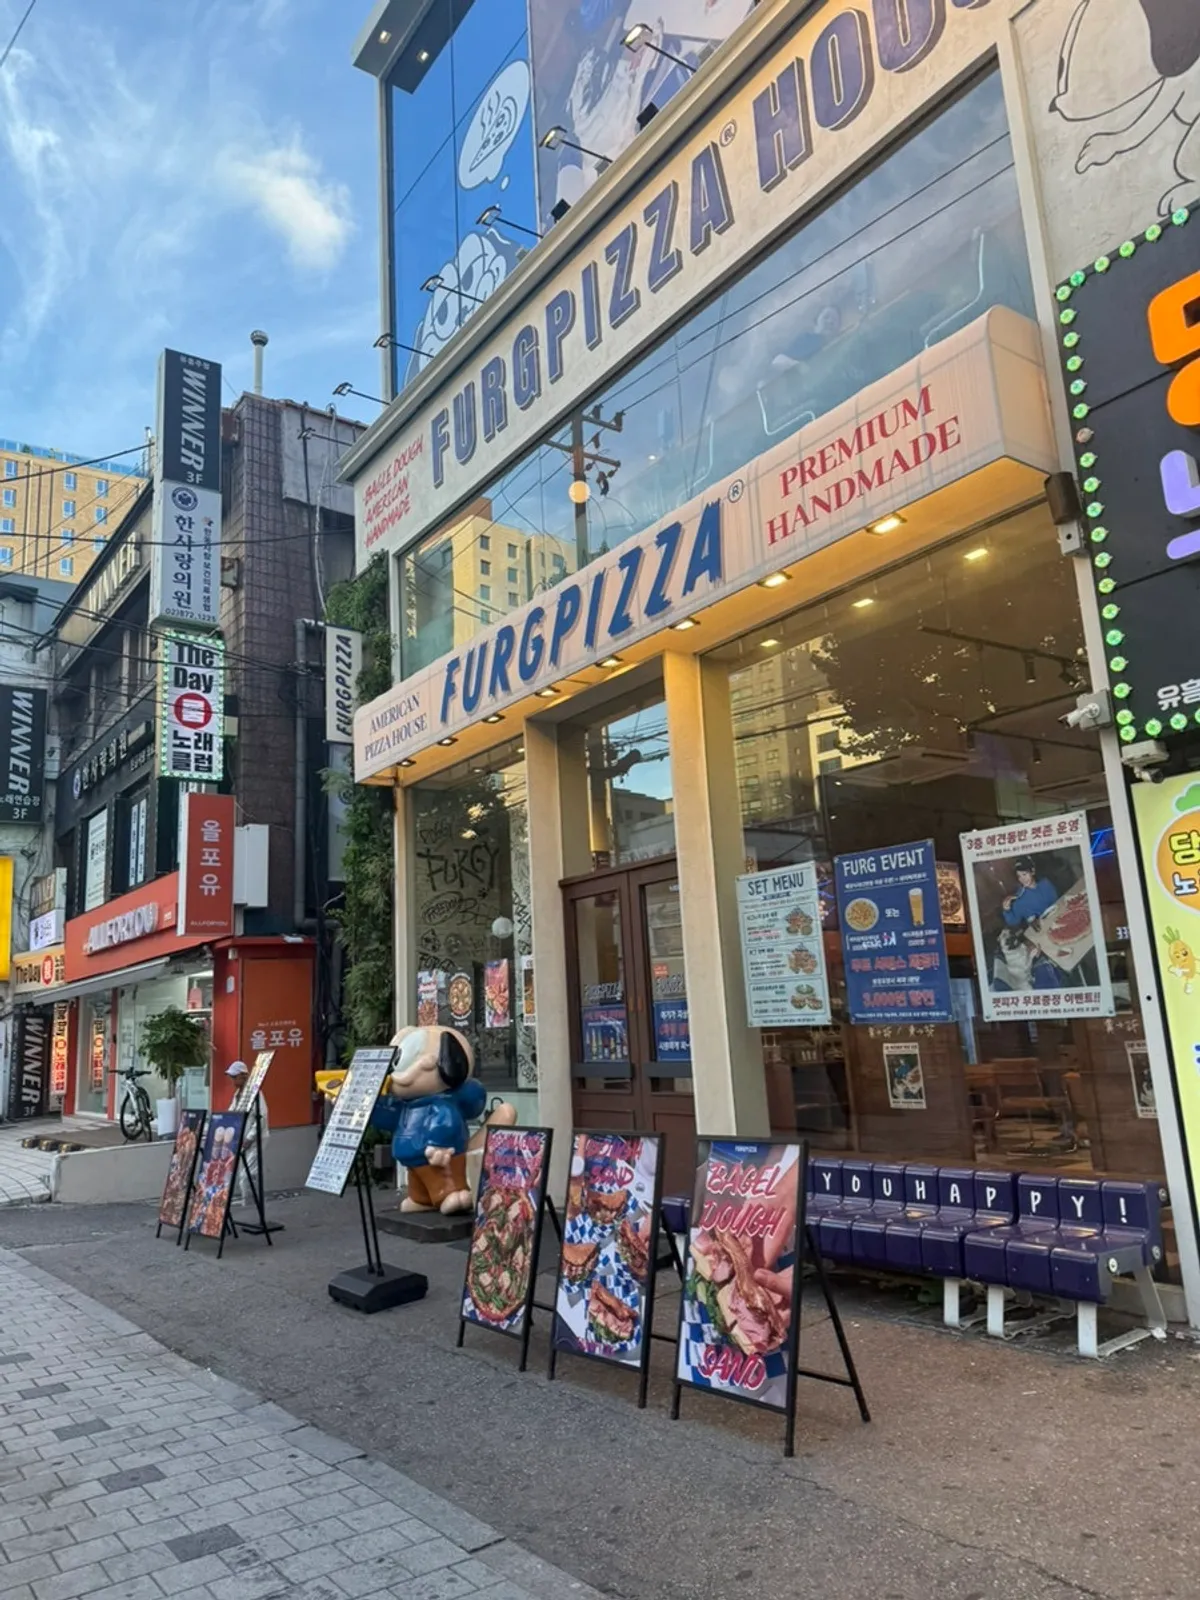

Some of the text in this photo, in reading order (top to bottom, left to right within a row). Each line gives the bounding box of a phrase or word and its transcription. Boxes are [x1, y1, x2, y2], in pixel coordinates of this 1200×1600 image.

[430, 142, 734, 488] FURGPIZZA
[752, 0, 990, 193] HOU
[181, 367, 207, 472] WINNER
[779, 384, 934, 498] PREMIUM
[187, 471, 203, 484] 3F
[767, 416, 961, 546] HANDMADE
[173, 514, 196, 609] 한사랑의원
[440, 499, 723, 724] FURGPIZZA
[173, 641, 215, 668] The
[173, 667, 214, 694] Day
[335, 633, 353, 738] FURGPIZZA
[369, 691, 421, 738] AMERICAN
[8, 690, 34, 795] WINNER
[172, 730, 214, 752] 노래
[364, 714, 428, 762] PIZZA HOUSE
[172, 751, 214, 773] 클럽
[12, 807, 28, 820] 3F
[1056, 817, 1080, 835] 운영
[199, 819, 222, 896] 올포유
[842, 847, 925, 878] FURG EVENT
[747, 871, 804, 897] SET MENU
[1173, 872, 1200, 897] 노
[250, 1027, 304, 1050] 올포유
[21, 1017, 44, 1104] WINNER
[23, 1106, 36, 1117] 3F
[705, 1161, 783, 1198] BAGEL
[699, 1200, 787, 1239] DOUGH
[697, 1343, 766, 1391] SAND
